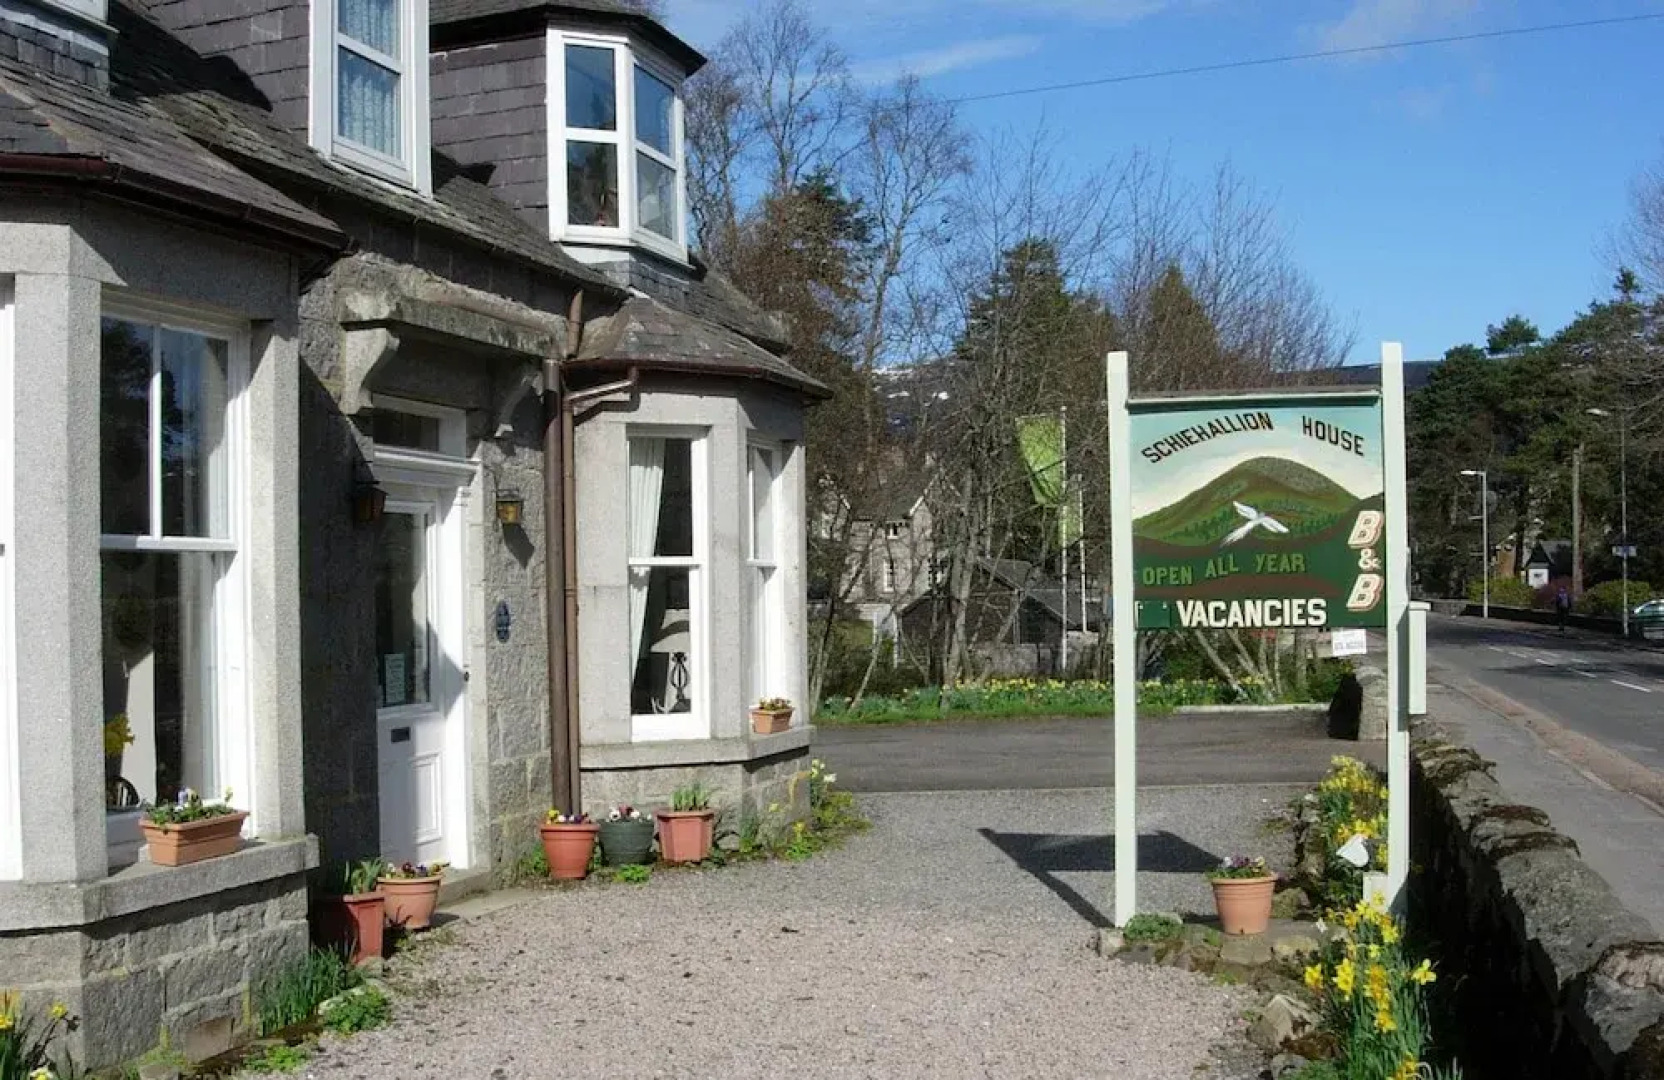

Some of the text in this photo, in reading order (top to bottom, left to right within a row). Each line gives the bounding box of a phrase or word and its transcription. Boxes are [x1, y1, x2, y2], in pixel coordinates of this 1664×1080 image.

[1141, 411, 1365, 464] SCHIEHALLION HOUSE
[1142, 553, 1306, 586] OPEN ALL YEAR
[1176, 598, 1327, 627] VACANCIES
